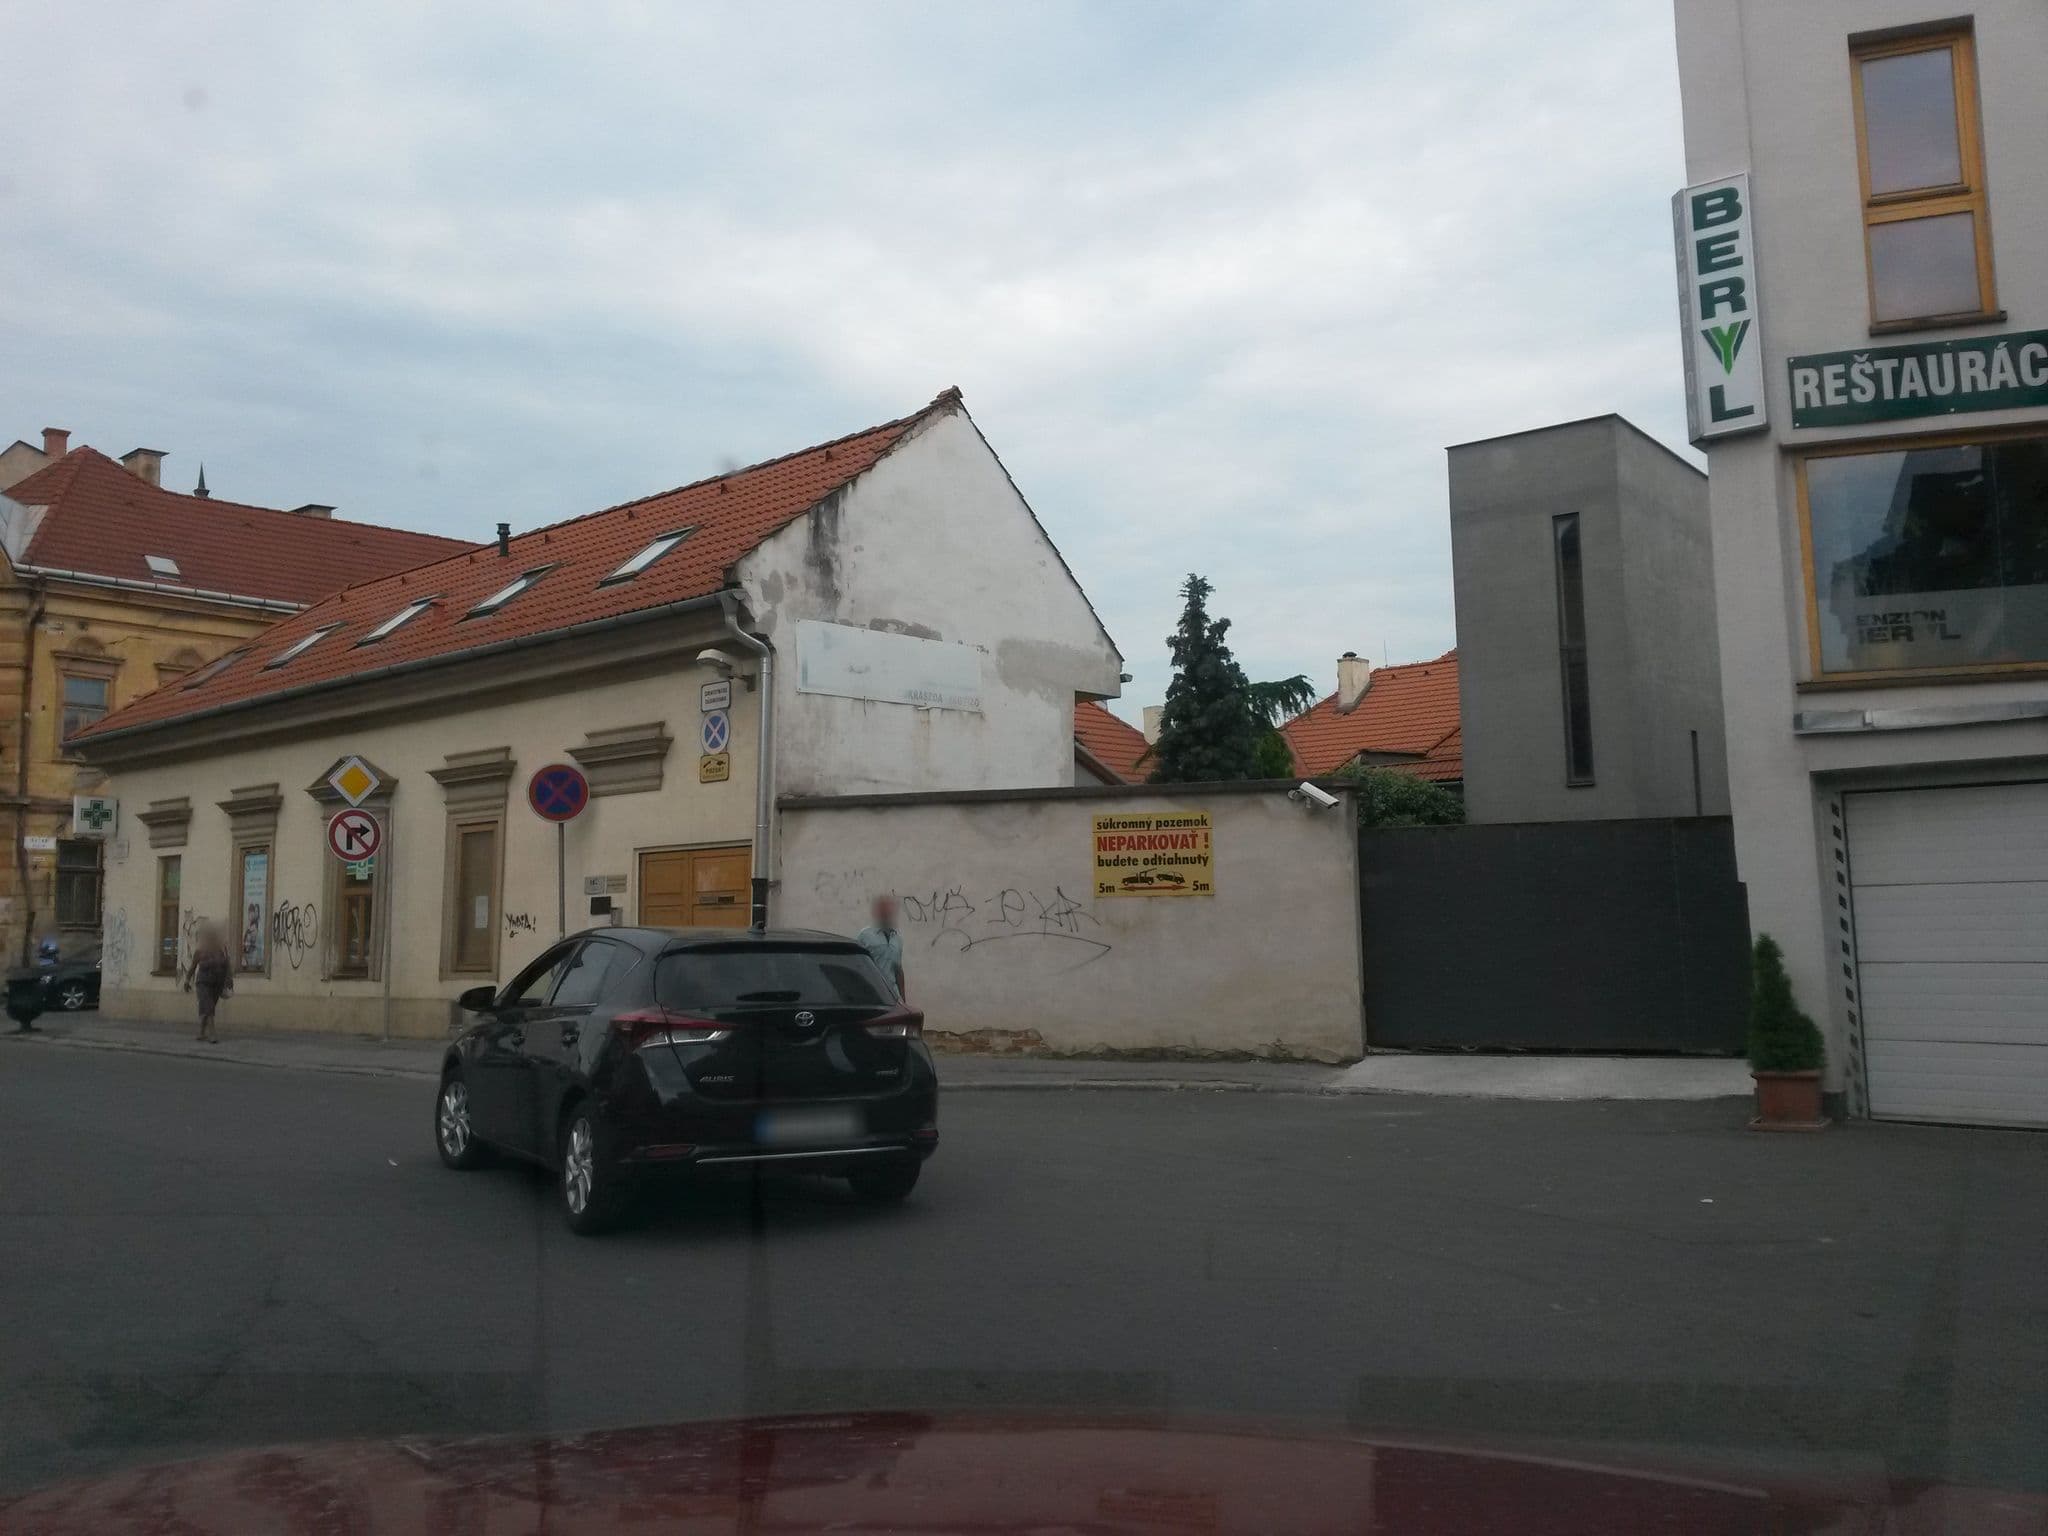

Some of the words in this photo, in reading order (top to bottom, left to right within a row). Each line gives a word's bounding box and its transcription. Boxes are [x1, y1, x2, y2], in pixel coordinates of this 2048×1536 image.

[1691, 186, 1755, 423] BERYL
[1793, 341, 2048, 409] REŠTAURÁC
[1096, 817, 1152, 831] súkromný
[1155, 814, 1208, 830] pozemok
[1097, 830, 1198, 851] NEPARKOVAŤ
[1097, 854, 1139, 868] budete
[1142, 852, 1209, 867] odtiahnutý
[1098, 882, 1116, 894] 5m
[1192, 880, 1210, 892] 5m
